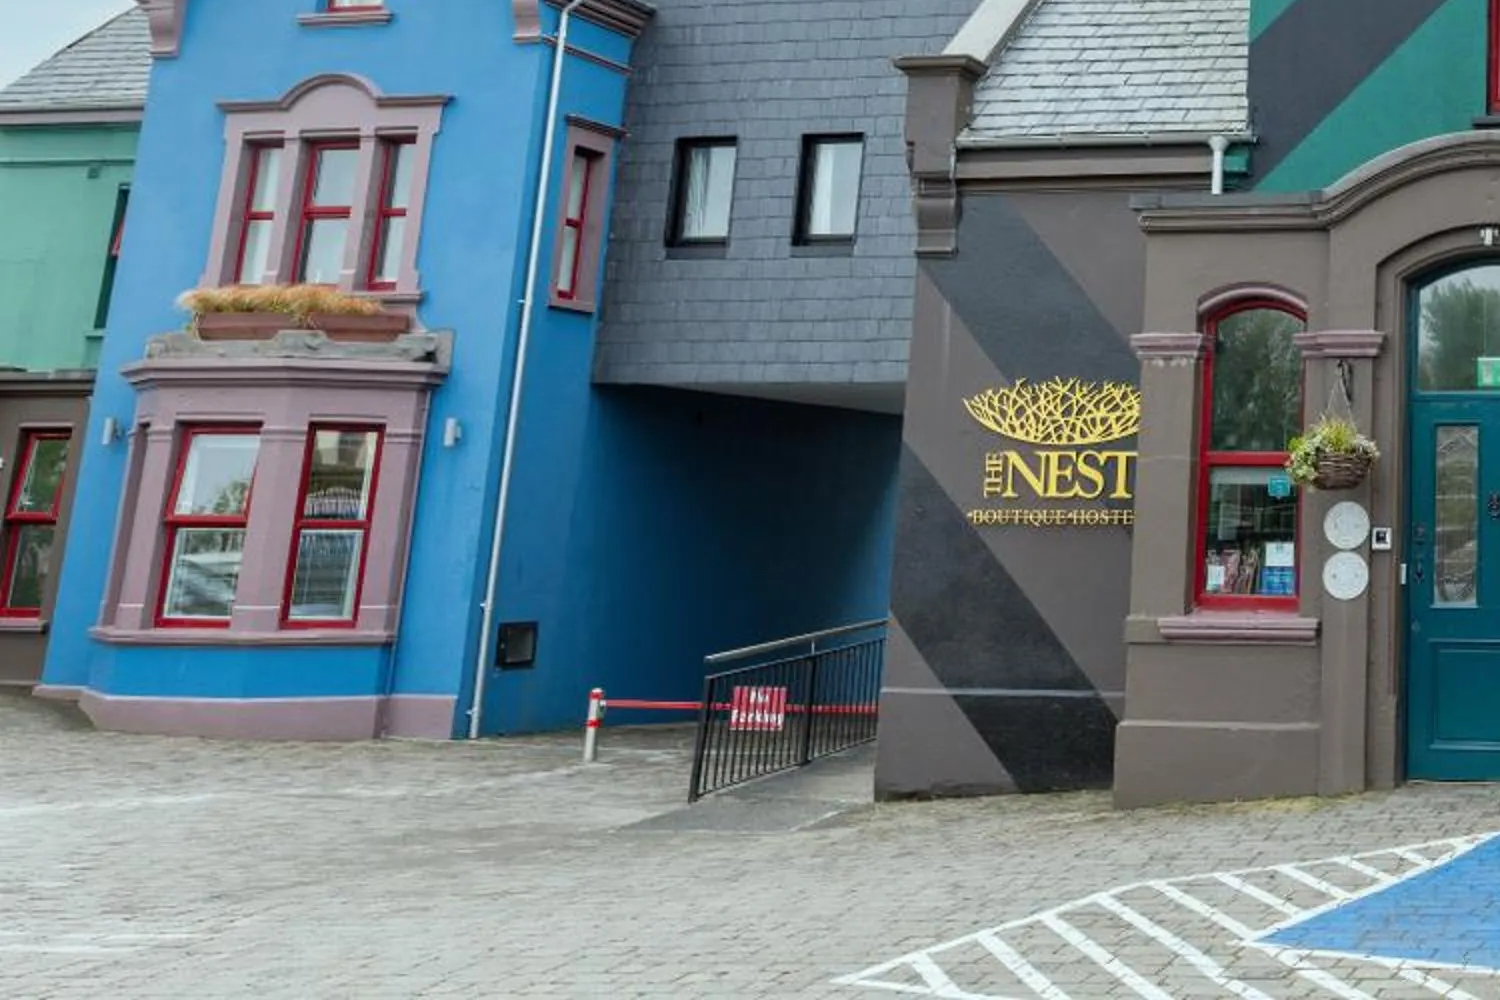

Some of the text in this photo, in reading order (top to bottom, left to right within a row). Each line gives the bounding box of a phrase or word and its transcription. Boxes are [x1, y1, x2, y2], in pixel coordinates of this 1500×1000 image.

[983, 450, 1138, 498] THE NEST
[973, 508, 1135, 527] BOUTIQUE HOSTE
